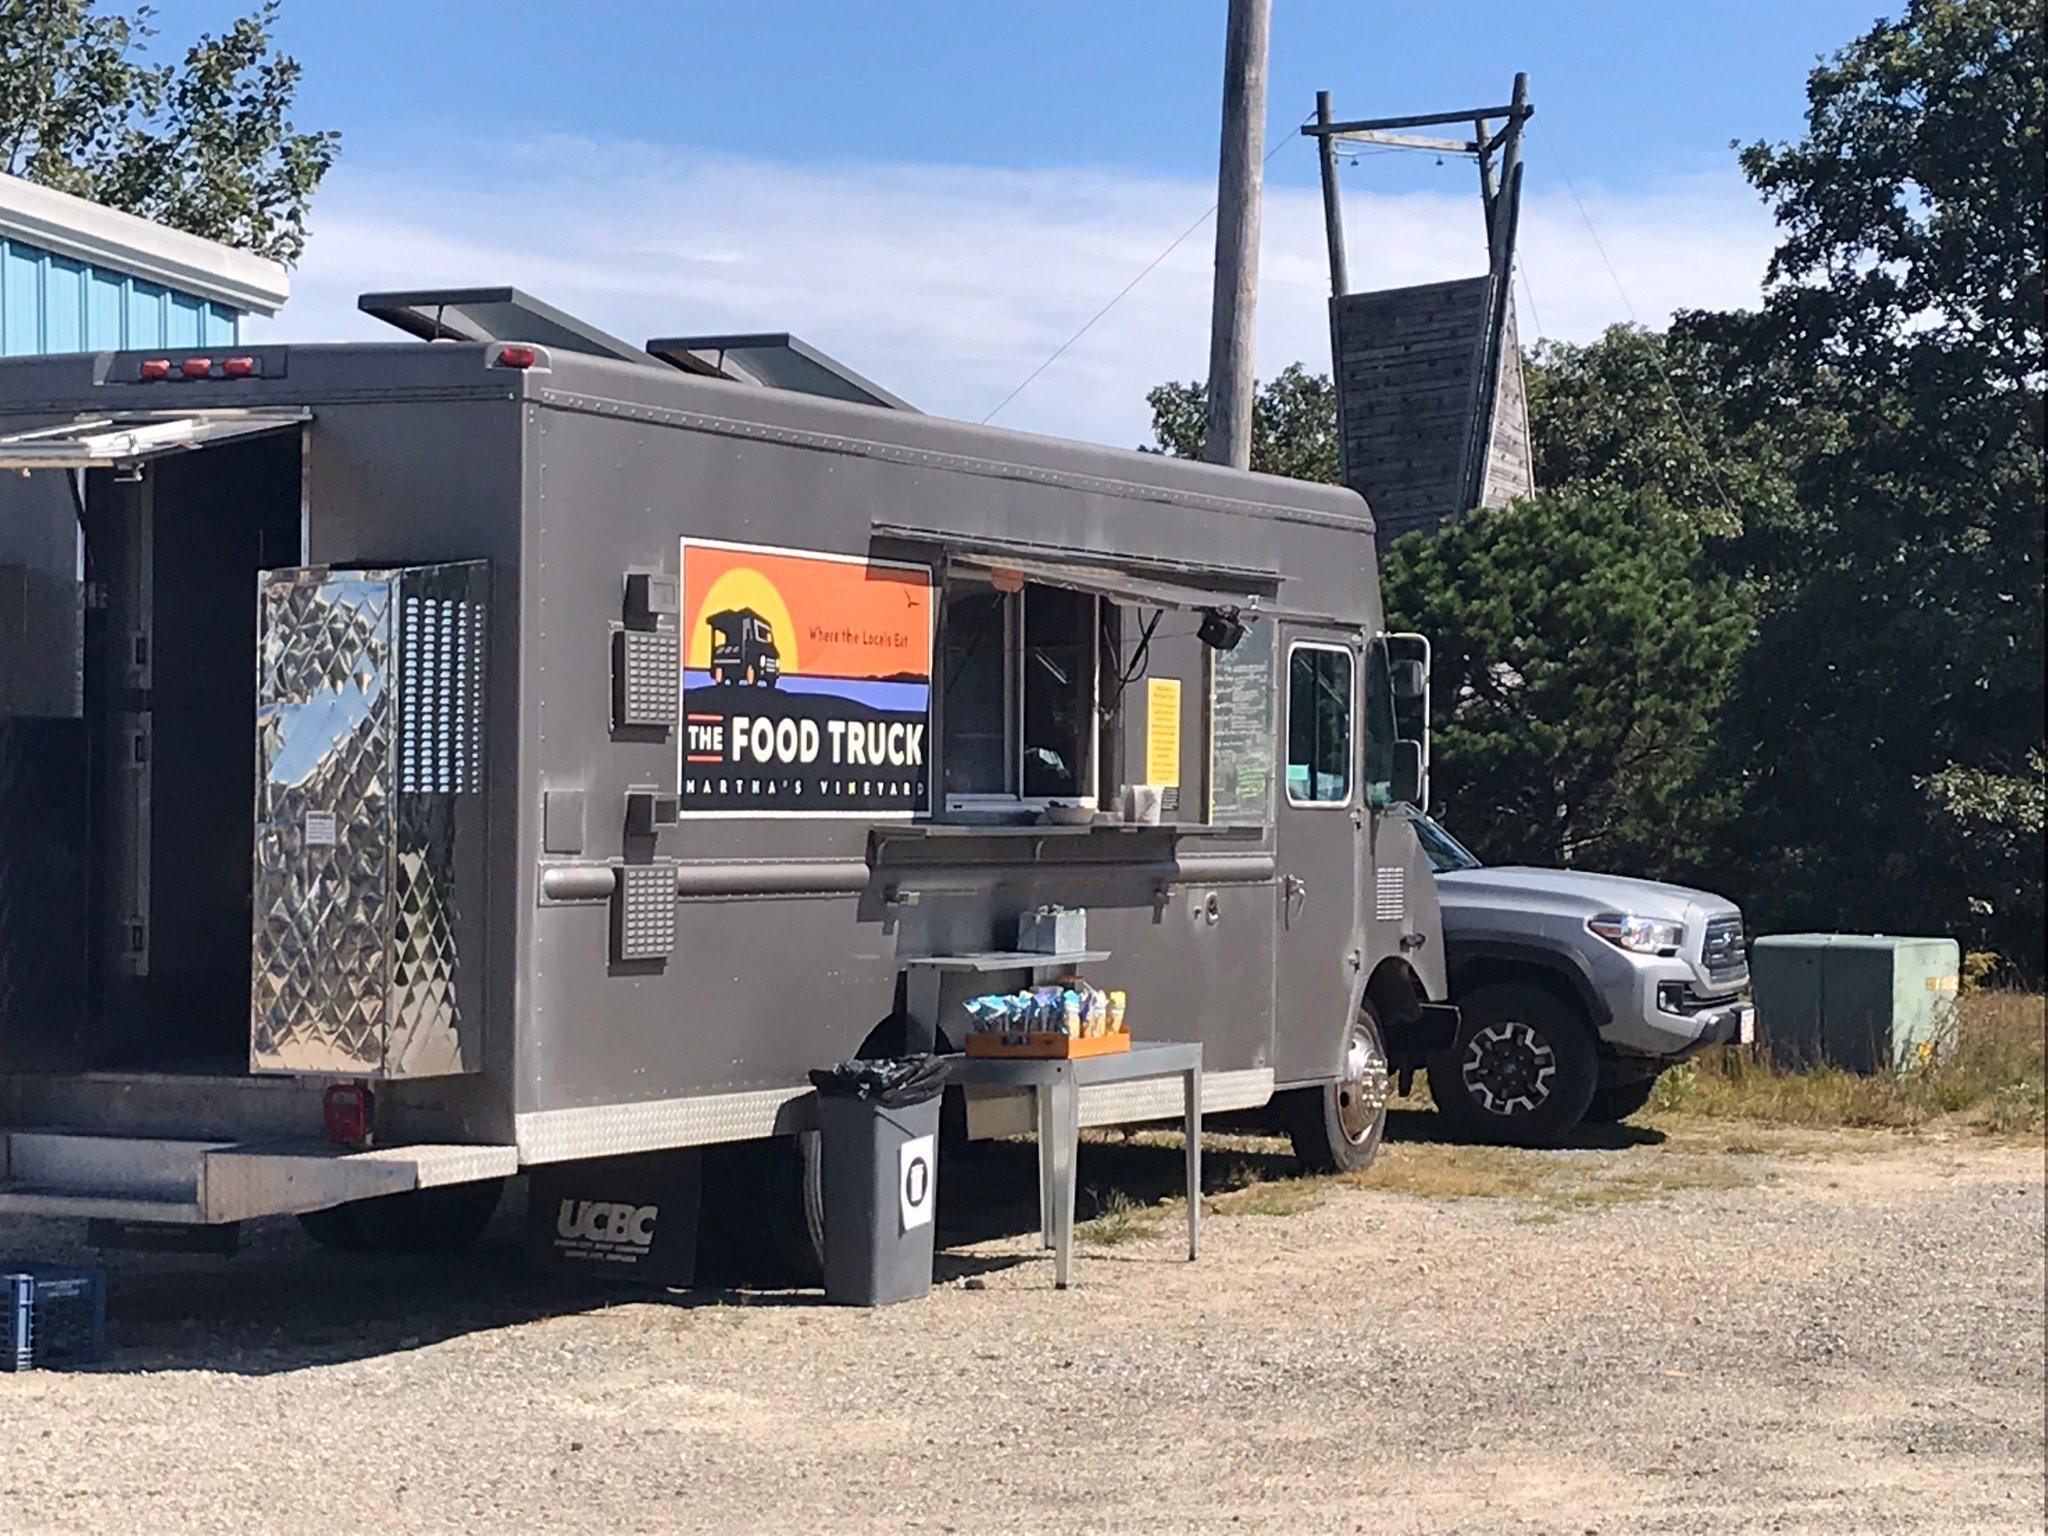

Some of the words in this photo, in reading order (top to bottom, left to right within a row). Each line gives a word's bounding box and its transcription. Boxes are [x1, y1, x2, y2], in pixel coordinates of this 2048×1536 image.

[687, 725, 723, 750] THE
[732, 716, 820, 763] FOOD
[827, 720, 924, 766] TRUCK
[685, 779, 802, 795] MARTHA'S
[820, 780, 924, 797] VINEYARD
[557, 1198, 658, 1246] UCBC
